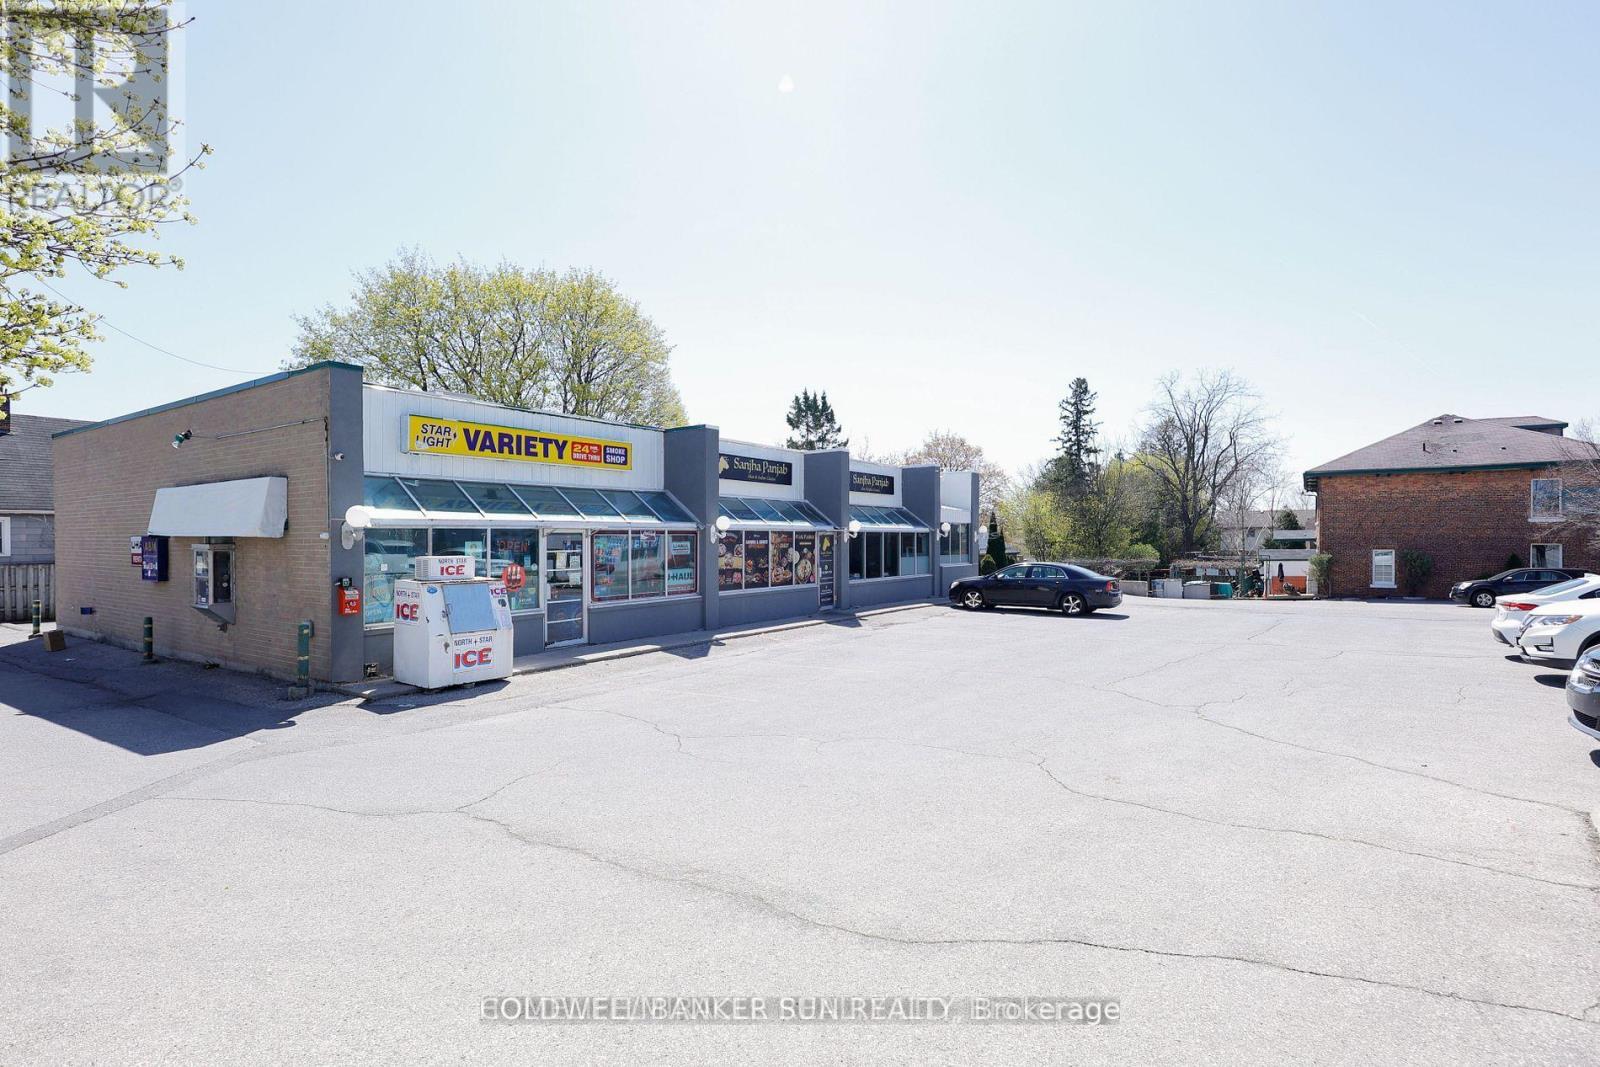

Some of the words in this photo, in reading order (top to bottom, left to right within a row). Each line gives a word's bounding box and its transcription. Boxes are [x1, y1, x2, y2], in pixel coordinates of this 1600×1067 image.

[421, 424, 452, 437] STAR
[463, 428, 568, 460] VARIETY
[573, 444, 590, 454] 24
[606, 447, 626, 455] SMOKE
[606, 455, 626, 463] SHOP
[733, 457, 762, 473] Sanjha
[499, 540, 529, 552] OPEN
[440, 565, 466, 576] ICE
[490, 587, 507, 596] ICE
[396, 603, 419, 621] ICE
[454, 639, 473, 647] NORTH
[479, 635, 493, 644] STAR
[454, 648, 492, 669] ICE
